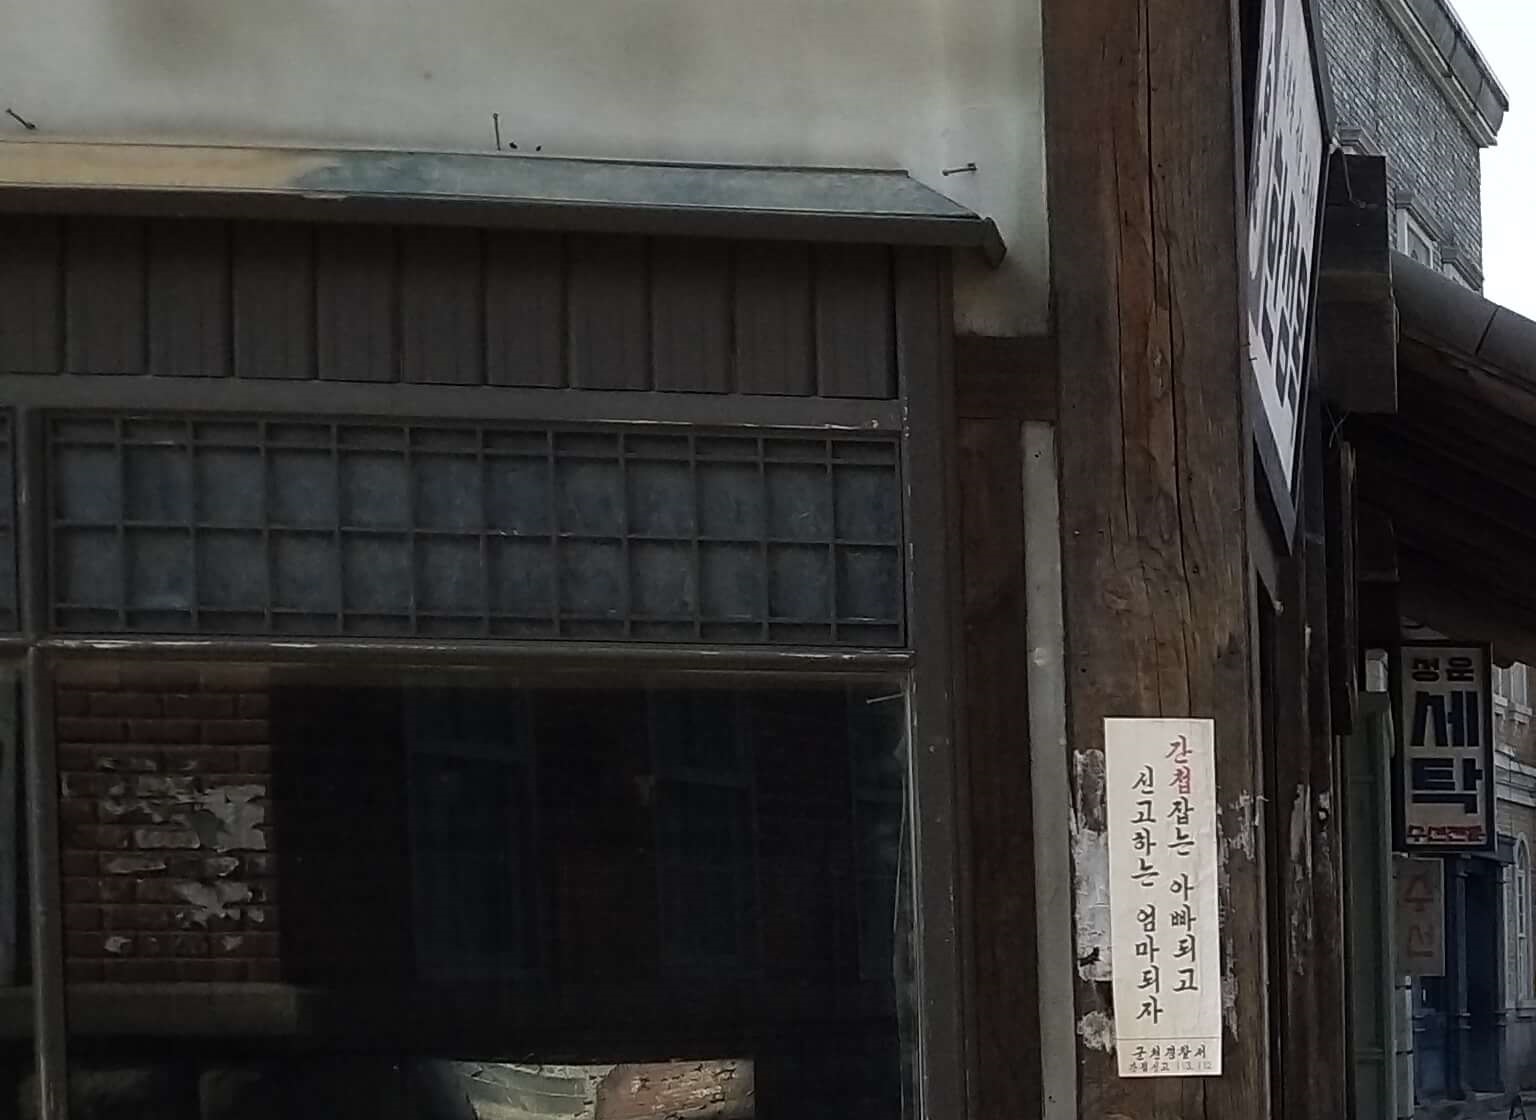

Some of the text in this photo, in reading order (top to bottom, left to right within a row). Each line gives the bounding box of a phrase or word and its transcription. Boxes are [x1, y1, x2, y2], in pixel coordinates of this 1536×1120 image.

[1166, 735, 1199, 992] 간첩잡는 아빠되고
[1410, 690, 1483, 814] 세탁
[1130, 765, 1163, 1024] 신고하는 엄마되자
